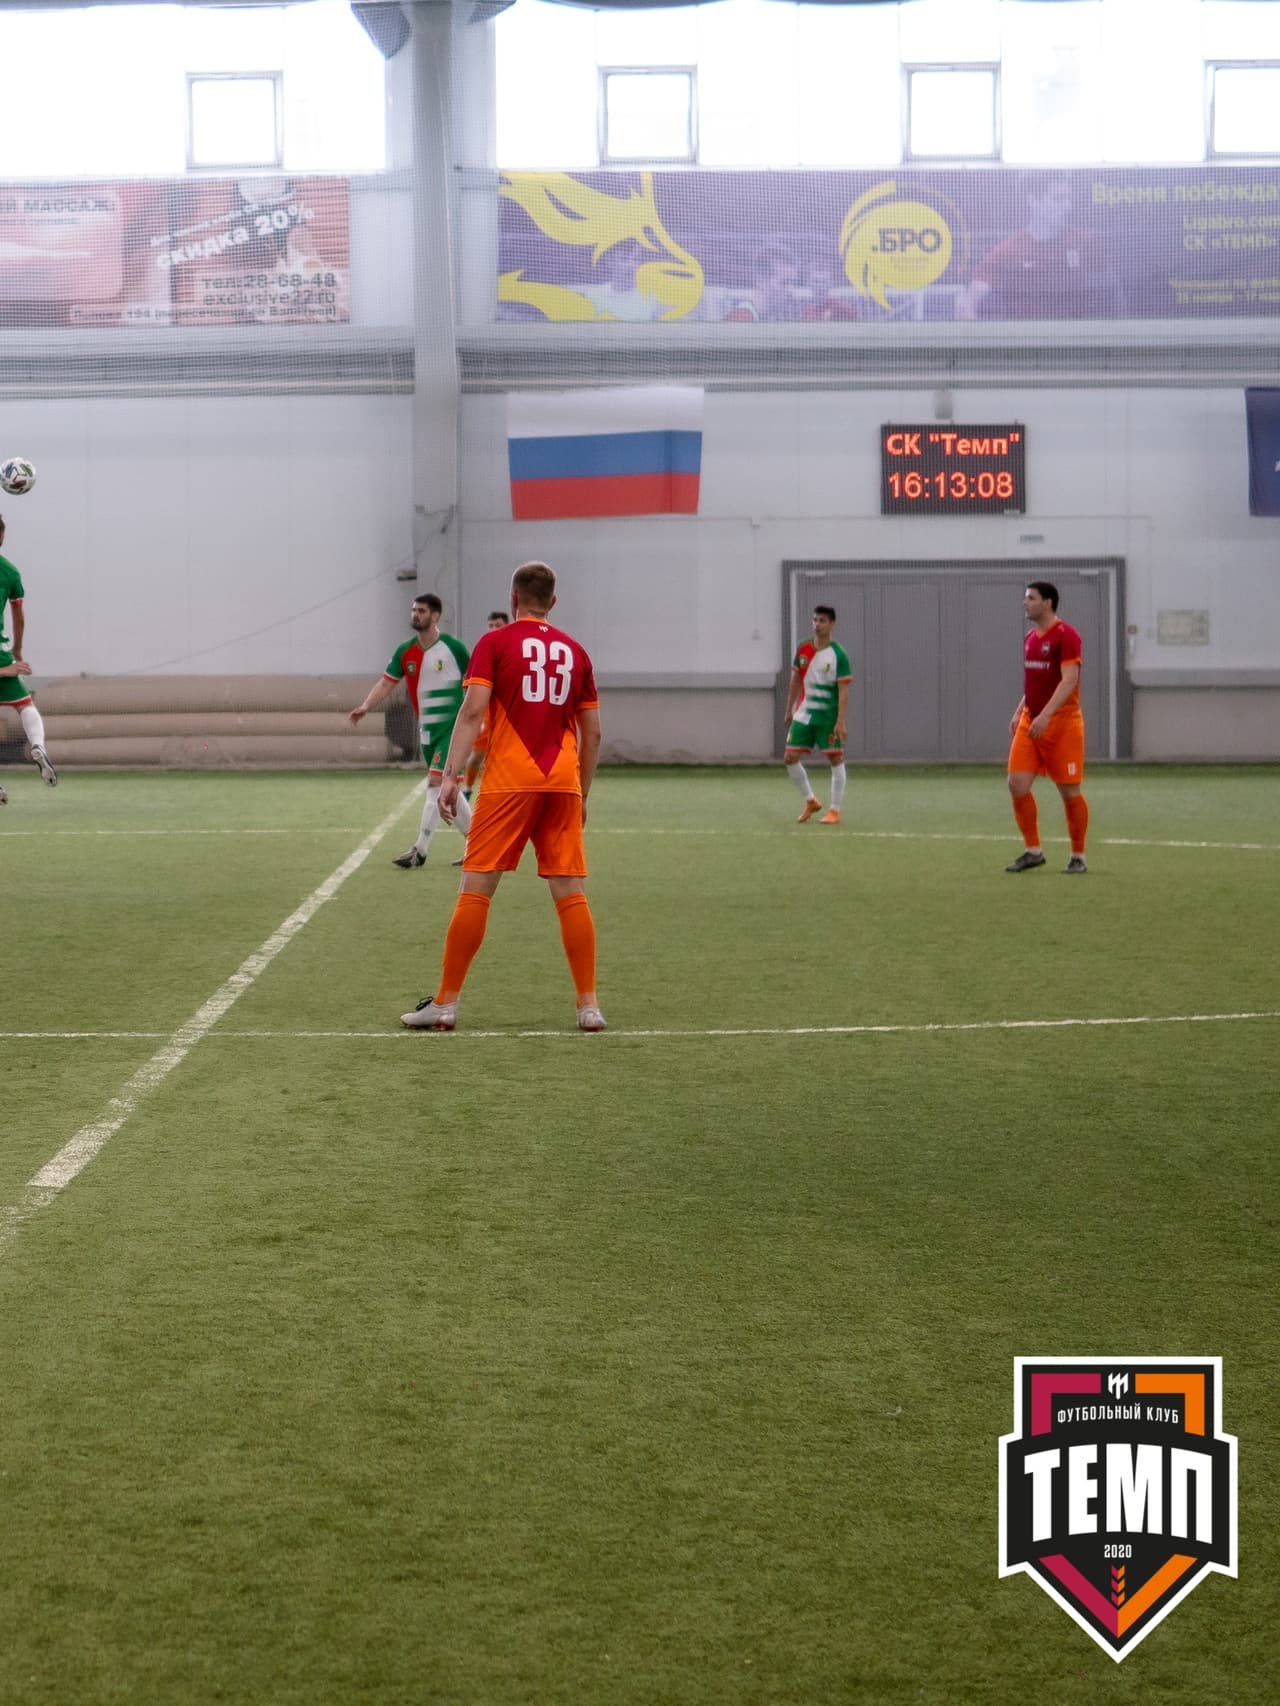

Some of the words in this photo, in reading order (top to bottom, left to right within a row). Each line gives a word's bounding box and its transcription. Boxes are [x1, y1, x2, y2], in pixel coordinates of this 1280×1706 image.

[1091, 182, 1167, 207] Время
[255, 202, 315, 236] 20%
[156, 227, 250, 268] скидка
[1182, 234, 1207, 251] СК
[886, 433, 921, 456] СК
[929, 433, 1020, 456] "Темп"
[888, 471, 1014, 499] 16:13:08
[522, 637, 574, 706] 33
